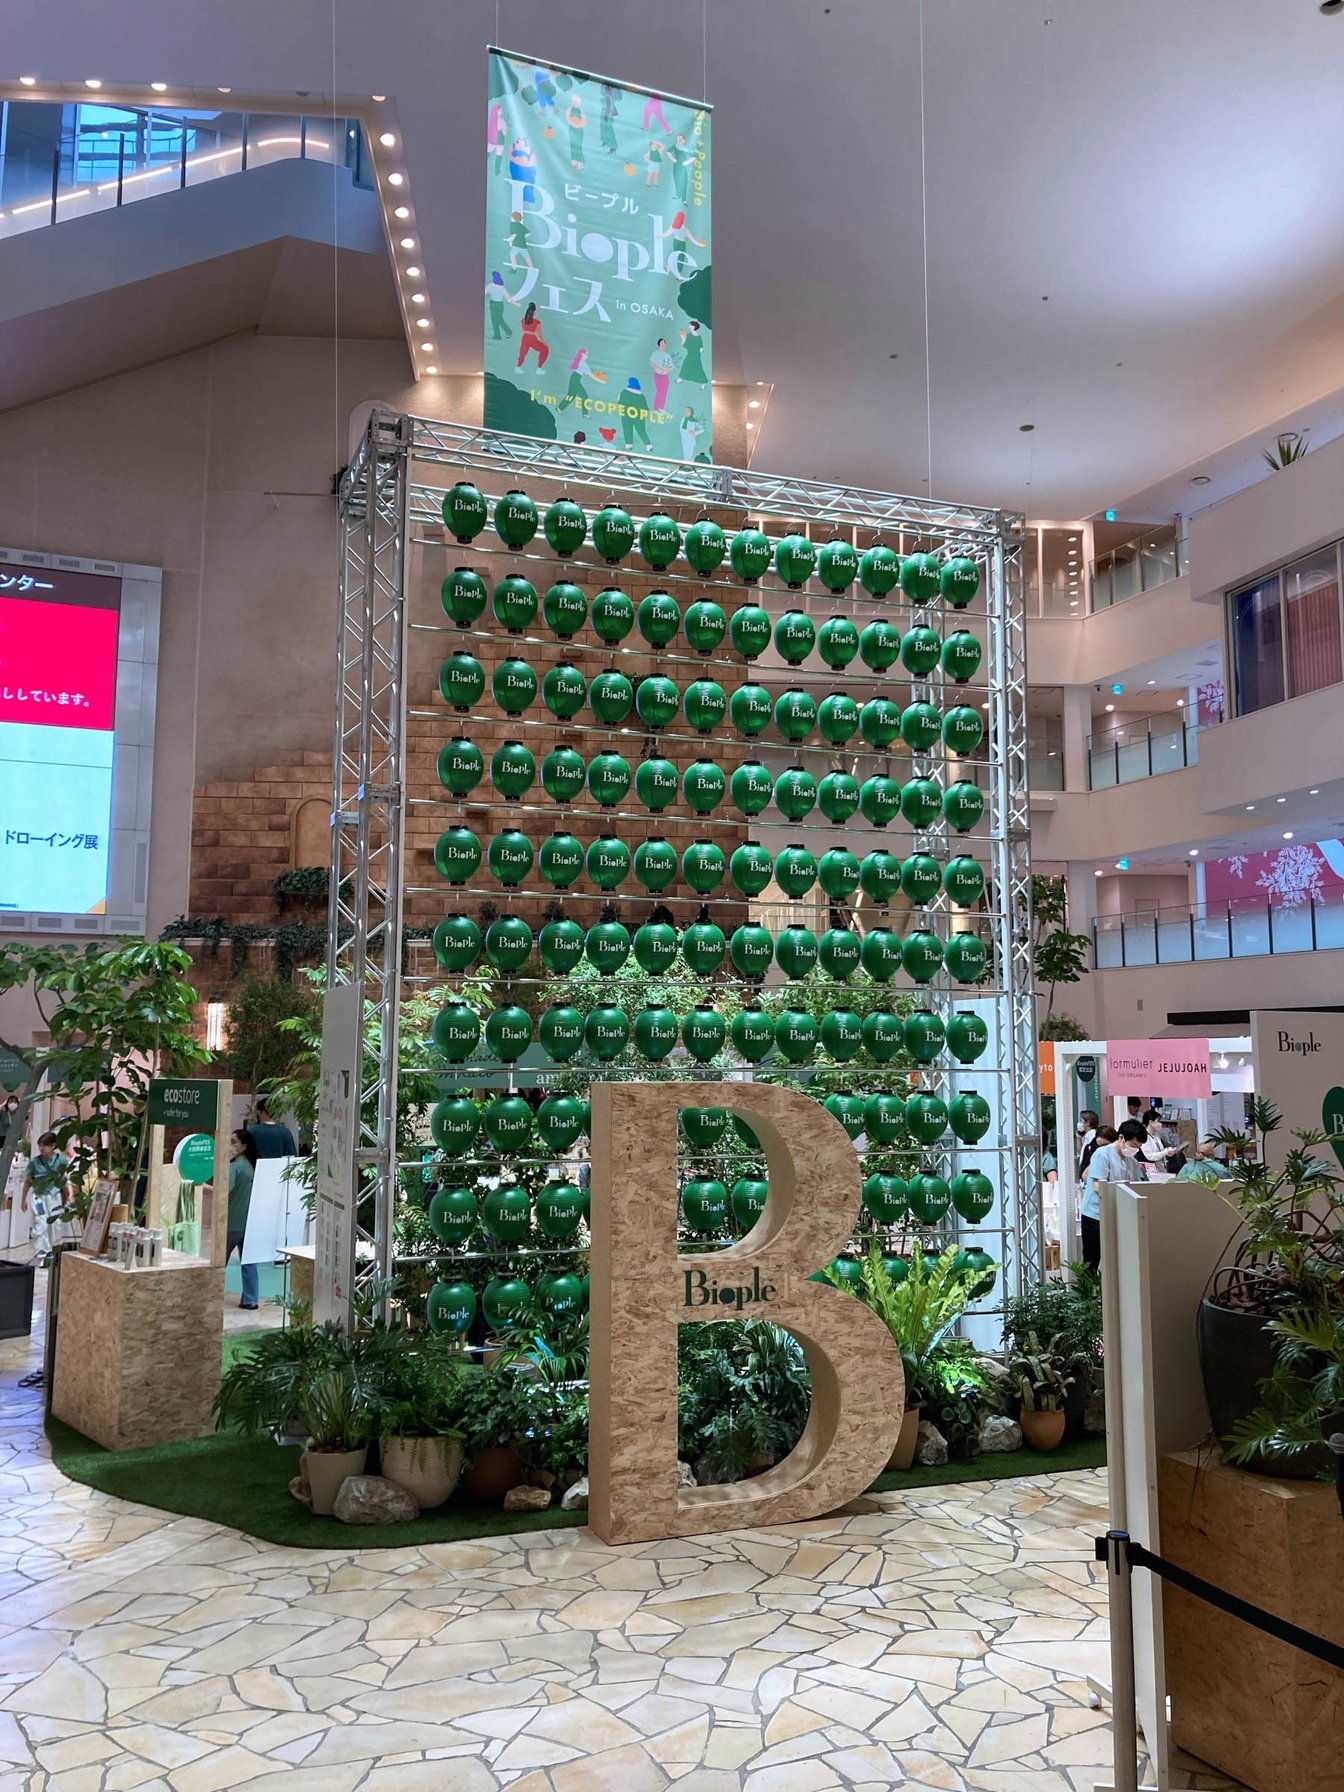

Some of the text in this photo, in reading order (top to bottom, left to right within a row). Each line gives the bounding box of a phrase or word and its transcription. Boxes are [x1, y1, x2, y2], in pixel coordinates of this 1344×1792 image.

[564, 183, 639, 215] ビープル
[504, 178, 698, 282] Biople
[503, 262, 612, 323] フェス
[616, 299, 674, 321] in OSAKA
[454, 499, 484, 514] Biople
[508, 507, 536, 523] Biople
[558, 516, 586, 530] Biople
[606, 521, 633, 535] Biople
[649, 529, 677, 543] Biople
[701, 535, 725, 549] Biople
[744, 543, 770, 557] Biople
[831, 555, 857, 568] Biople
[873, 560, 898, 573] Biople
[953, 570, 979, 582] Biople
[454, 585, 484, 600] Biople
[506, 592, 535, 607] Biople
[558, 598, 586, 612] Biople
[604, 605, 632, 619] Biople
[652, 607, 678, 621] Biople
[700, 616, 725, 630] Biople
[741, 621, 768, 633] Biople
[786, 627, 814, 640] Biople
[829, 633, 856, 645] Biople
[914, 641, 939, 653] Biople
[450, 671, 480, 684] Biople
[507, 675, 535, 690] Biople
[557, 681, 585, 696] Biople
[601, 687, 629, 701] Biople
[701, 696, 725, 709] Biople
[791, 707, 816, 720] Biople
[833, 710, 858, 722] Biople
[956, 721, 980, 733] Biople
[452, 757, 481, 772] Biople
[501, 761, 531, 775] Biople
[556, 766, 584, 780] Biople
[603, 771, 629, 784] Biople
[697, 778, 722, 791] Biople
[748, 780, 773, 793] Biople
[5, 829, 99, 850] ドローイング展
[448, 847, 478, 860] Biople
[500, 849, 530, 863] Biople
[552, 853, 581, 866] Biople
[600, 855, 627, 868] Biople
[645, 857, 673, 870] Biople
[699, 859, 724, 873] Biople
[789, 864, 815, 876] Biople
[914, 870, 940, 882] Biople
[956, 874, 982, 885] Biople
[444, 936, 476, 948] Biople
[498, 936, 528, 949] Biople
[554, 938, 582, 951] Biople
[599, 940, 627, 953] Biople
[697, 941, 723, 953] Biople
[744, 943, 771, 956] Biople
[833, 946, 858, 959] Biople
[449, 1027, 478, 1040] Biople
[501, 1027, 531, 1040] Biople
[553, 1025, 582, 1038] Biople
[597, 1026, 626, 1038] Biople
[650, 1026, 677, 1039] Biople
[692, 1026, 721, 1039] Biople
[744, 1028, 772, 1041] Biople
[790, 1029, 816, 1042] Biople
[875, 1030, 900, 1042] Biople
[1278, 1030, 1322, 1056] Biople
[1158, 1063, 1207, 1073] JEJUJOAH
[163, 1086, 200, 1104] ecostore
[498, 1118, 528, 1131] Biople
[550, 1115, 579, 1128] Biople
[700, 1114, 725, 1127] Biople
[880, 1112, 904, 1124] Biople
[923, 1112, 948, 1125] Biople
[443, 1119, 474, 1133] Biople
[701, 1200, 726, 1212] Biople
[748, 1199, 765, 1211] Bio
[443, 1211, 474, 1224] Biople
[499, 1209, 528, 1222] Biople
[549, 1206, 578, 1218] Biople
[683, 1266, 777, 1311] Biople
[438, 1307, 470, 1320] Biople
